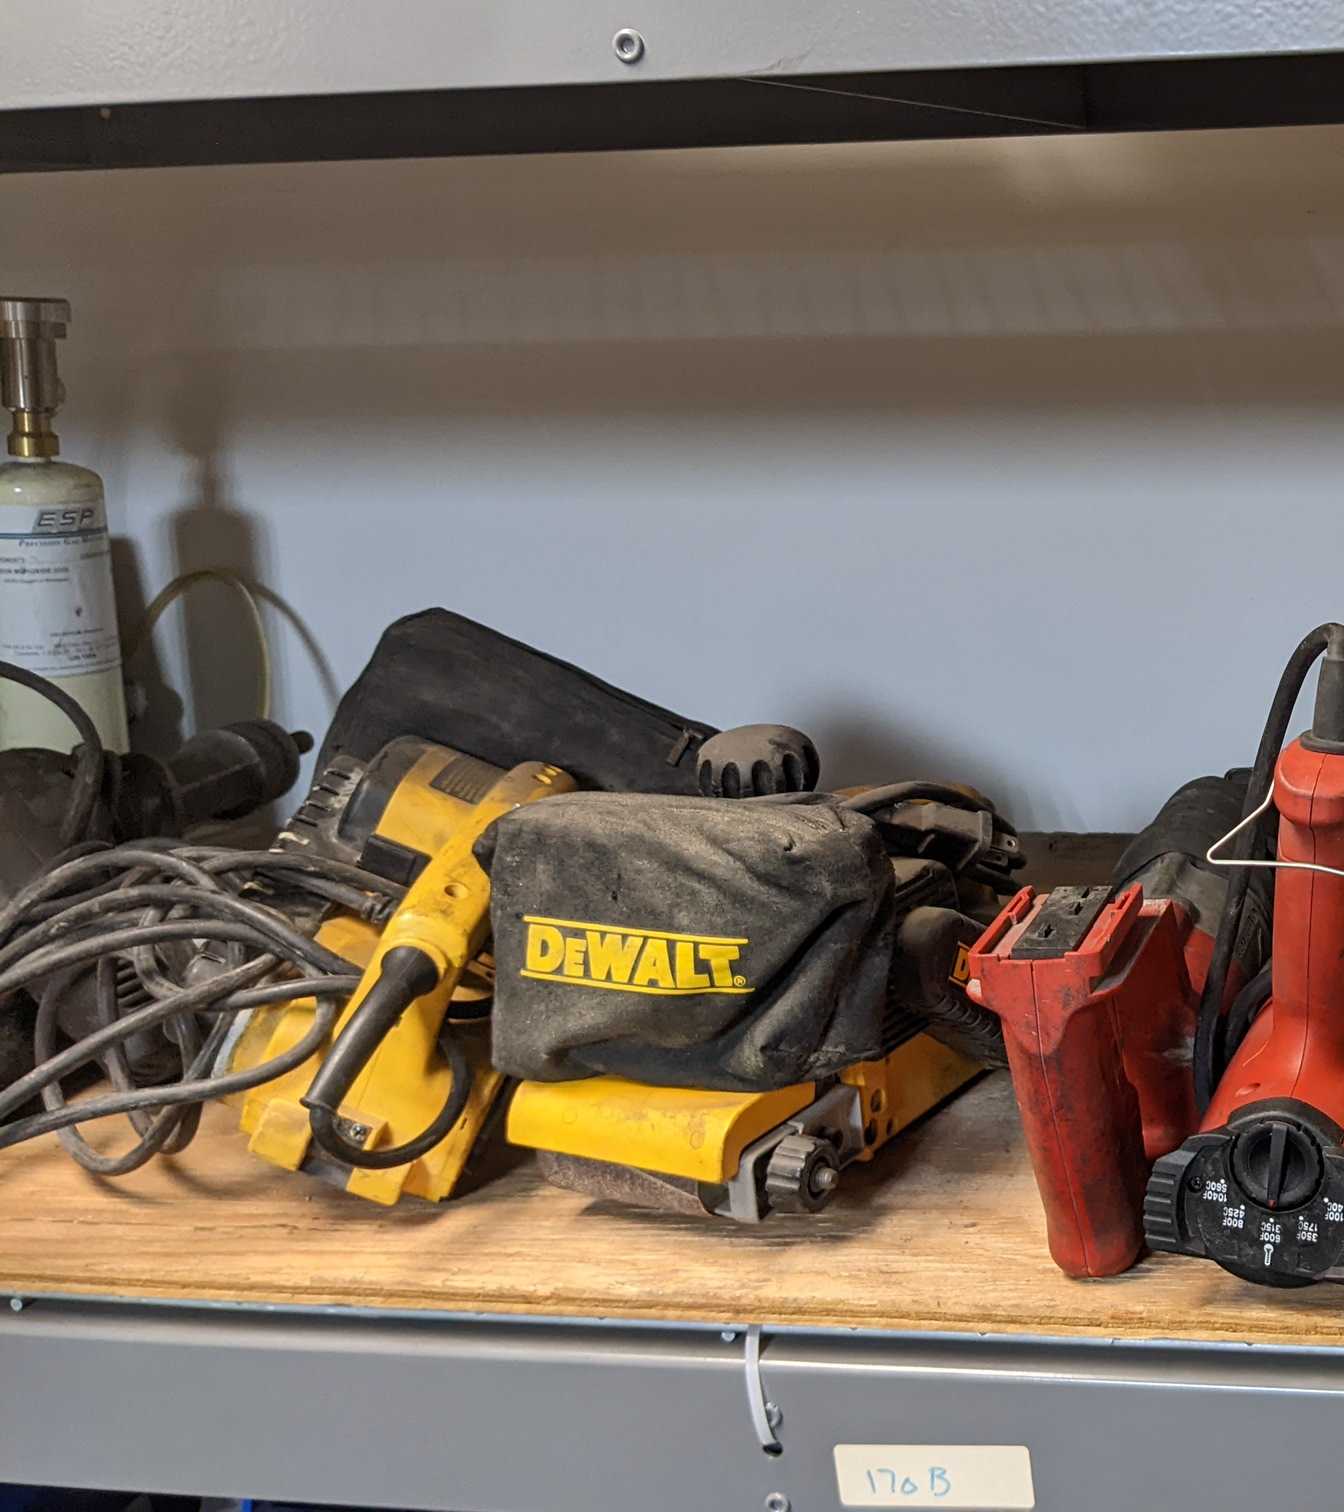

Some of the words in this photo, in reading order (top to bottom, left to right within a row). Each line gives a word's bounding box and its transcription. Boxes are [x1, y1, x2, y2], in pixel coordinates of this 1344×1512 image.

[38, 509, 94, 526] ESP
[1202, 1190, 1228, 1202] 1040F
[1223, 1206, 1246, 1219] 425C
[1326, 1202, 1344, 1213] 40C
[1324, 1211, 1344, 1222] 100F
[1222, 1217, 1244, 1229] 800F
[1261, 1221, 1281, 1233] 315C
[1298, 1220, 1318, 1232] 175C
[1259, 1232, 1281, 1243] 600F
[1296, 1230, 1318, 1243] 350F
[928, 1466, 951, 1497] B
